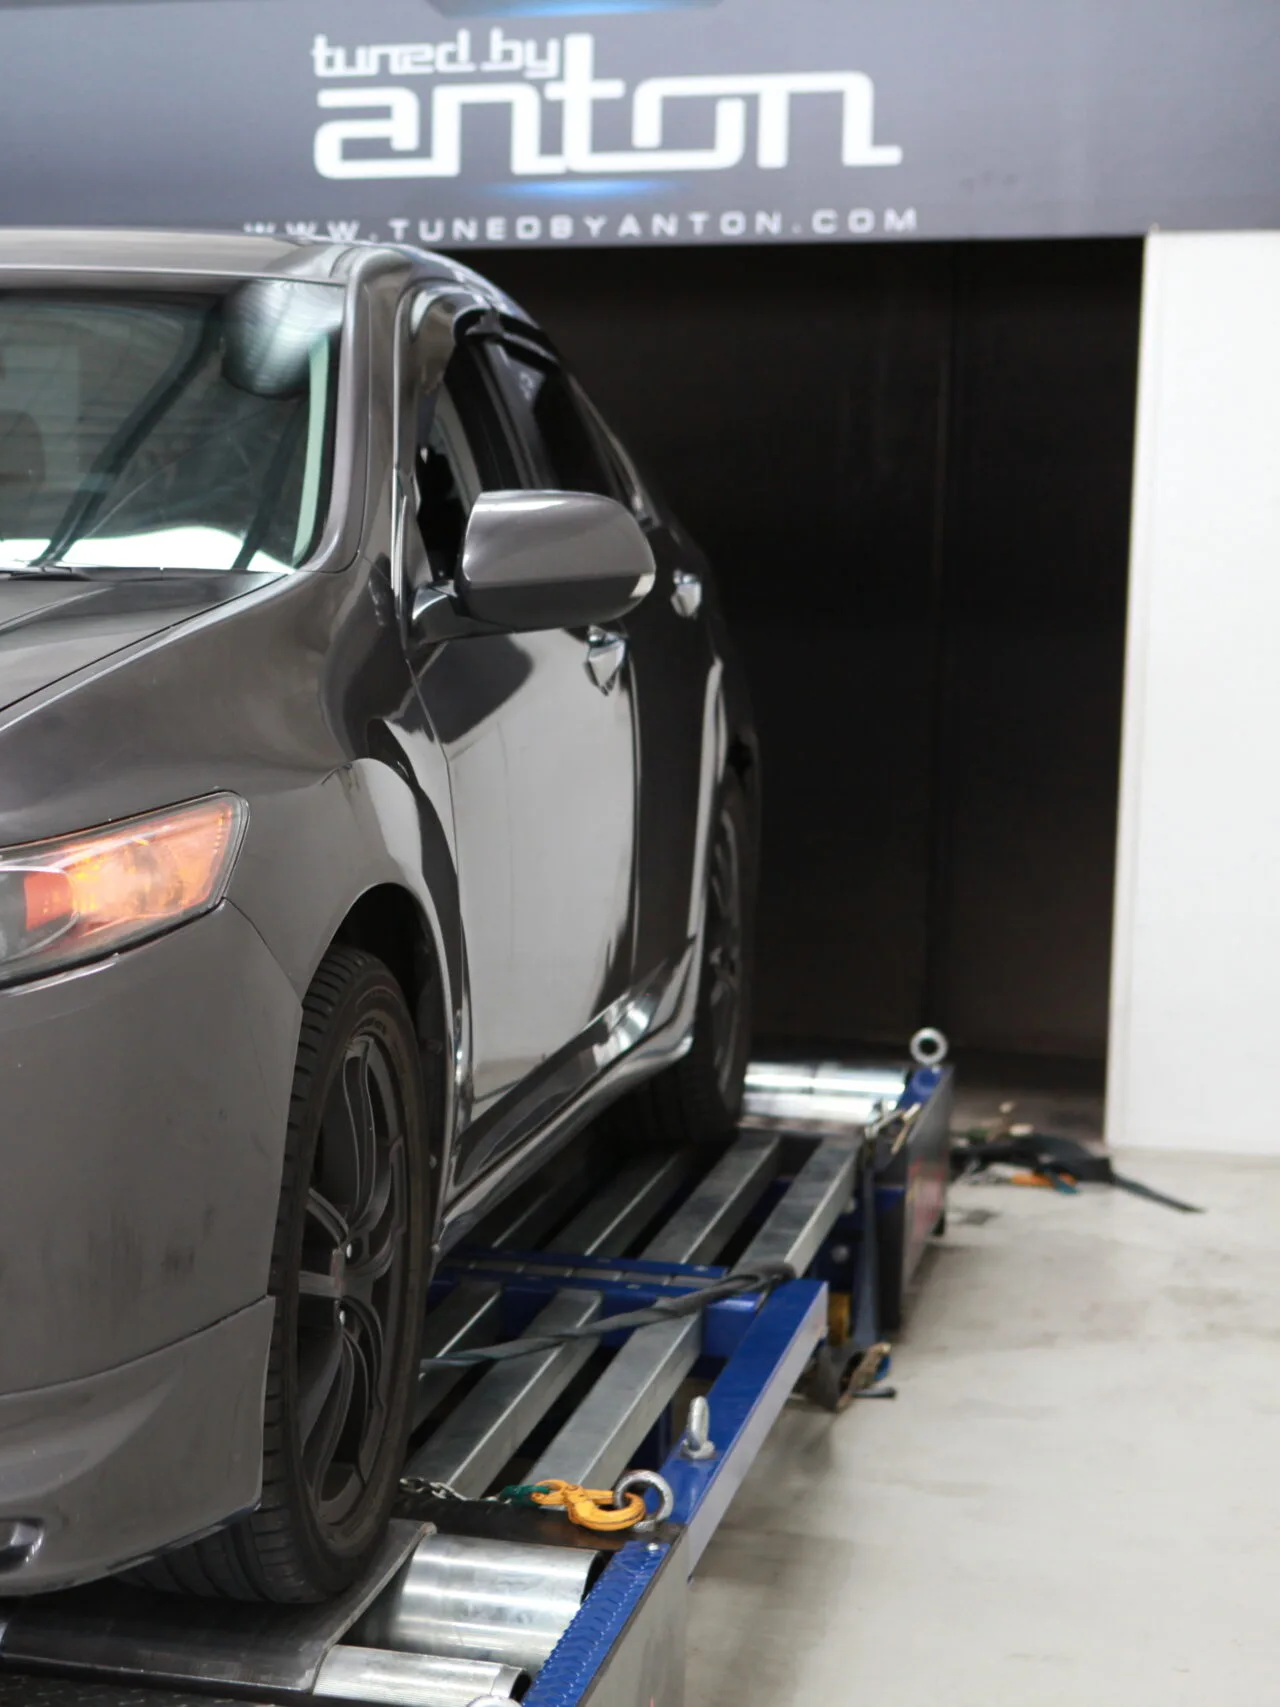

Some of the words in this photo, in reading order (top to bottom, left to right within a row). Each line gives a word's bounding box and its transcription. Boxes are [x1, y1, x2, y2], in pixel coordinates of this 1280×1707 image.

[311, 28, 477, 77] tuned
[480, 27, 561, 79] by
[314, 33, 904, 179] anton
